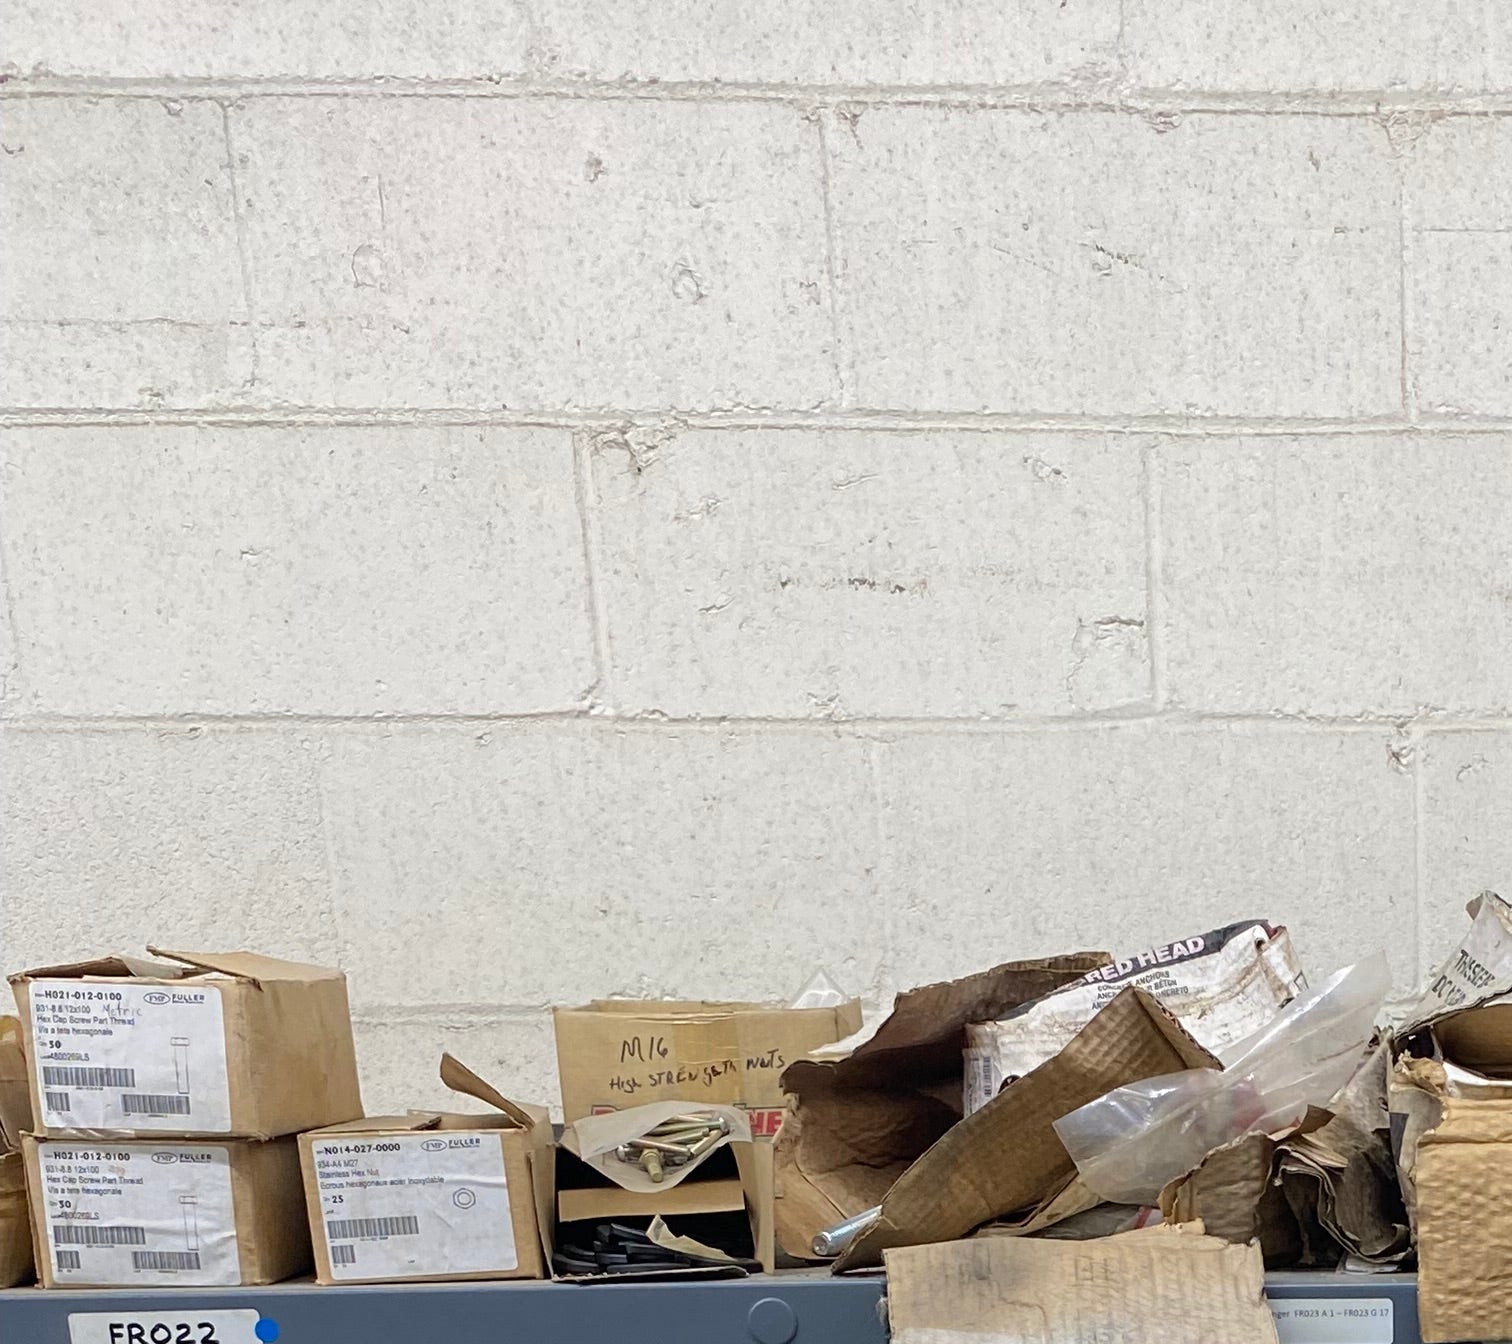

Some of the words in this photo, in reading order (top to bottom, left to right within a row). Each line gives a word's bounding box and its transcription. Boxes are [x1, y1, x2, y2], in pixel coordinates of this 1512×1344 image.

[1084, 958, 1134, 985] RED
[1137, 935, 1205, 969] HEAD
[1135, 970, 1170, 986] ANCHORS
[45, 990, 122, 1001] H021-012-0100
[172, 993, 205, 1001] FULLER
[36, 1016, 51, 1024] Hex
[52, 1016, 67, 1025] Cap
[69, 1017, 92, 1025] Screw
[93, 1018, 109, 1026] Part
[110, 1018, 135, 1026] Thread
[449, 1138, 481, 1146] FULLER
[324, 1142, 401, 1155] N014-027-0000
[53, 1152, 131, 1162] H021-012-0100
[351, 1169, 366, 1177] Hex
[46, 1176, 61, 1184] Hex
[62, 1177, 77, 1185] Cap
[1294, 1309, 1319, 1318] FR023
[1321, 1309, 1328, 1317] A
[1343, 1308, 1369, 1317] FR023
[1370, 1308, 1377, 1316] G
[1380, 1308, 1390, 1317] 17
